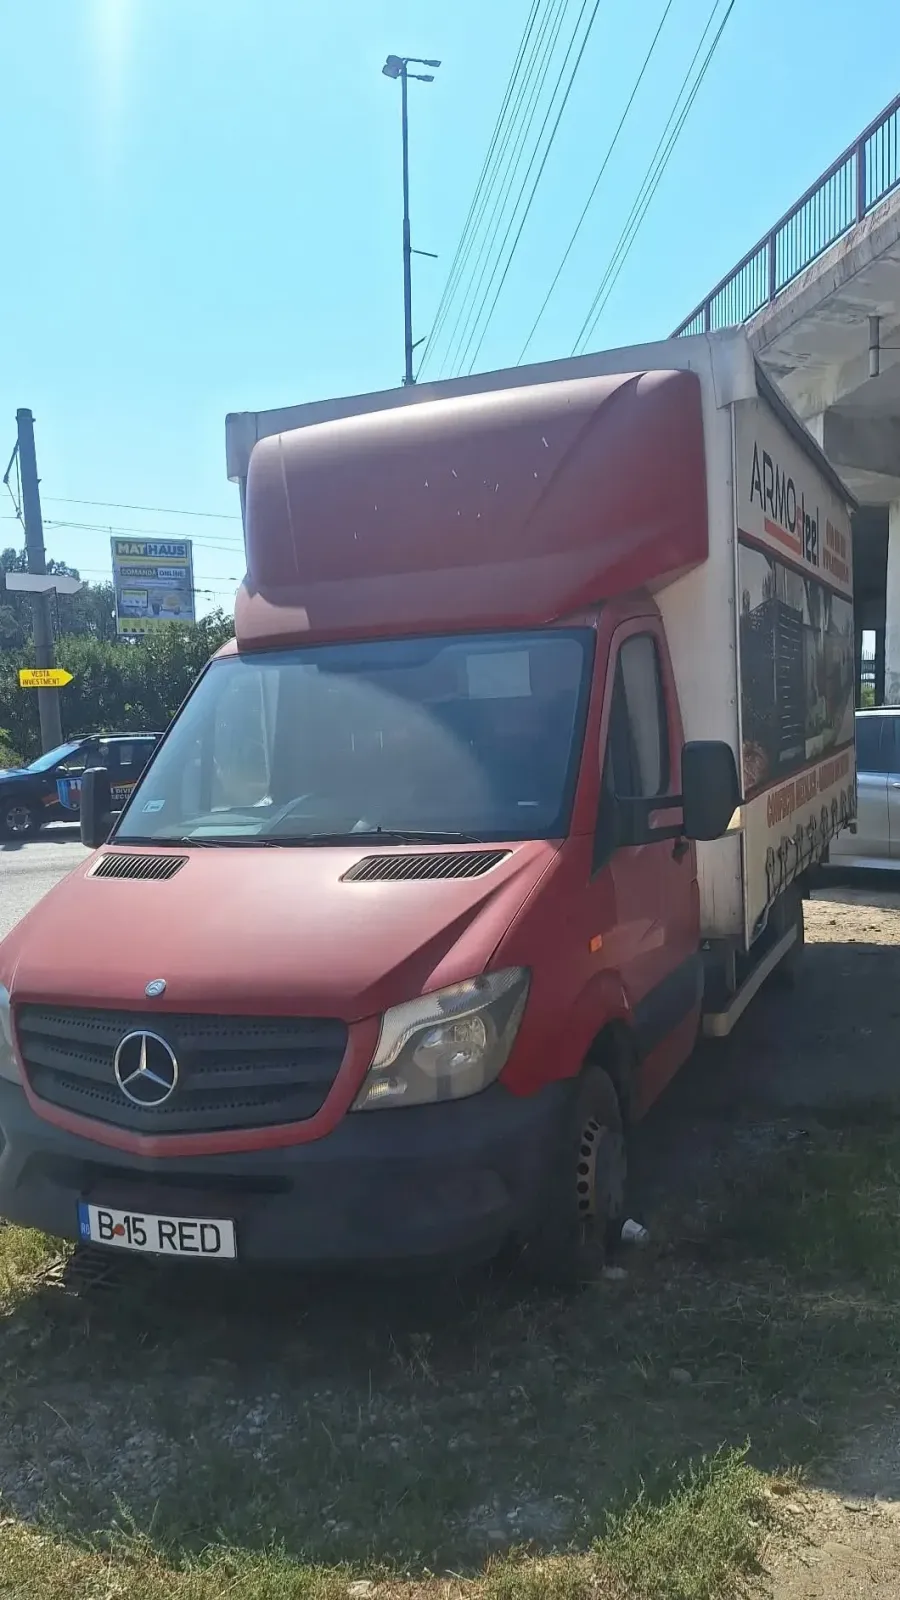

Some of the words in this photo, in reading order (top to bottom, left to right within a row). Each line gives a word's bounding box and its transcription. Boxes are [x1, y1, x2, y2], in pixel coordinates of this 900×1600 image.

[31, 670, 51, 678] VESTA
[22, 678, 60, 686] INVESTMENT
[98, 1211, 114, 1241] B
[123, 1215, 147, 1247] 15
[157, 1220, 221, 1253] RED
